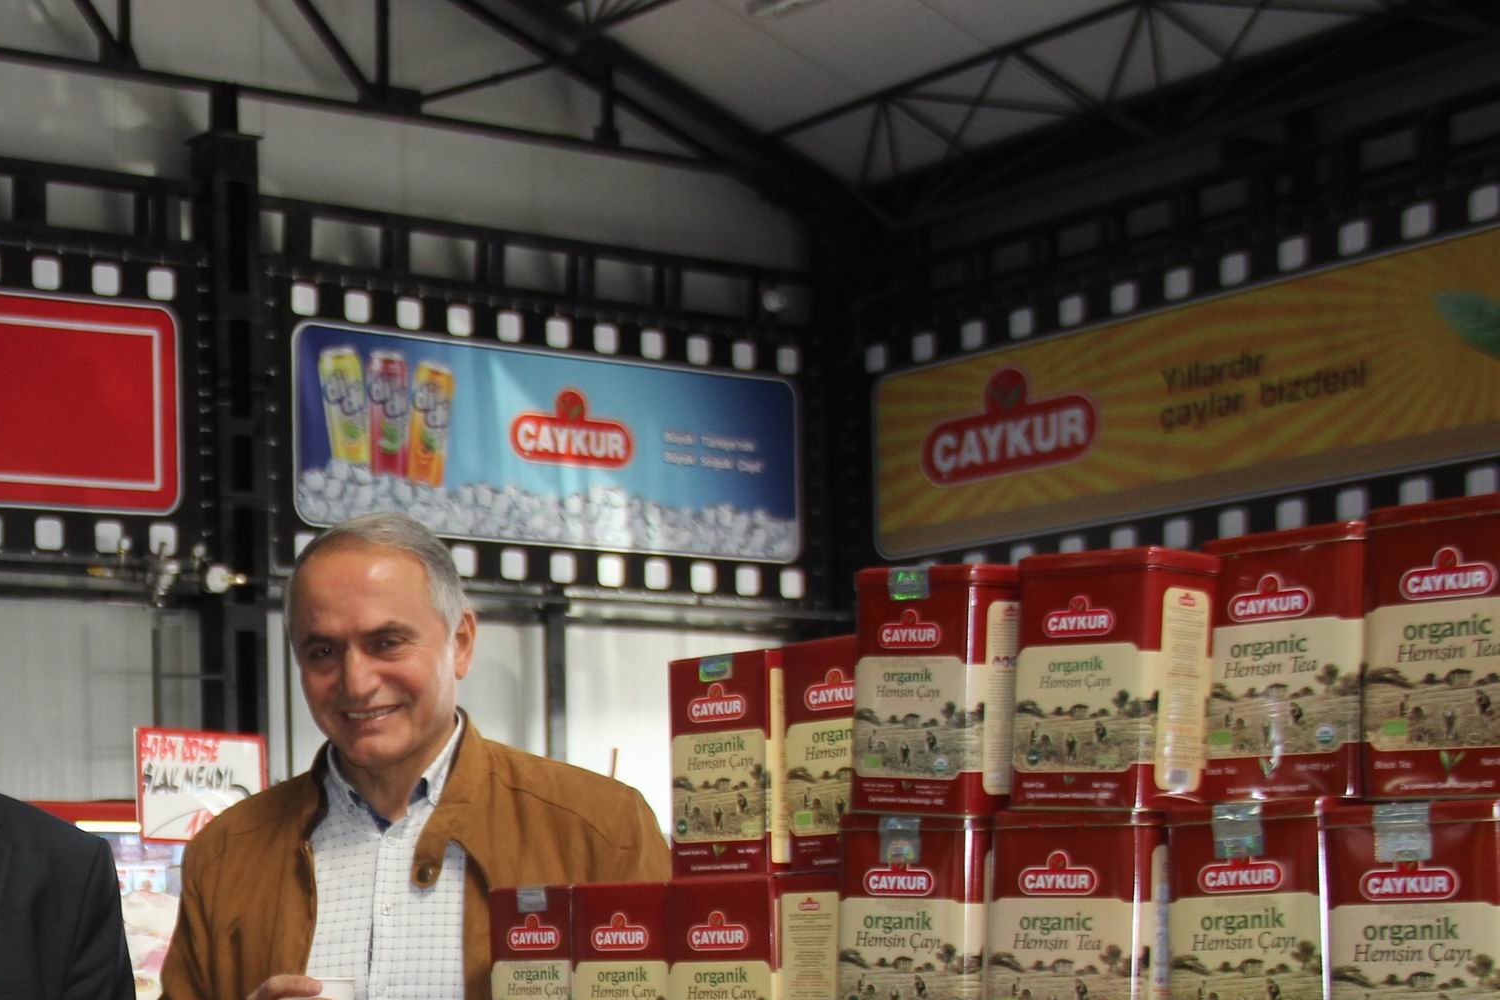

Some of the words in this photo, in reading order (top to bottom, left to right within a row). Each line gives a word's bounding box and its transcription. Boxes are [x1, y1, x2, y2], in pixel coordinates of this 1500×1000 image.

[518, 422, 626, 460] ÇAYKUR
[932, 406, 1088, 478] ÇAYKUR
[1047, 613, 1108, 634] ÇAYKUR
[1404, 614, 1491, 645] organic
[882, 628, 936, 645] ÇAYKUR
[1230, 634, 1307, 660] organic
[1048, 656, 1104, 676] organik
[1290, 656, 1317, 674] Tea
[883, 669, 933, 686] organik
[809, 687, 854, 709] ÇAYKU
[692, 698, 742, 719] ÇAYKUR
[694, 735, 745, 757] organik
[812, 727, 853, 747] organ
[869, 874, 928, 892] ÇAYKUR
[1204, 868, 1277, 887] ÇAYKUR
[1366, 876, 1449, 897] ÇAYKUR
[864, 911, 933, 935] organik
[1019, 913, 1093, 936] organic
[1200, 907, 1285, 935] organik
[1363, 917, 1459, 945] organik
[511, 931, 555, 948] ÇAYKUR
[596, 931, 645, 949] ÇAYKUR
[692, 931, 744, 949] ÇAYKUR
[1077, 934, 1102, 951] Tea
[513, 966, 560, 985] organik
[598, 967, 647, 986] organik
[694, 967, 748, 986] organik
